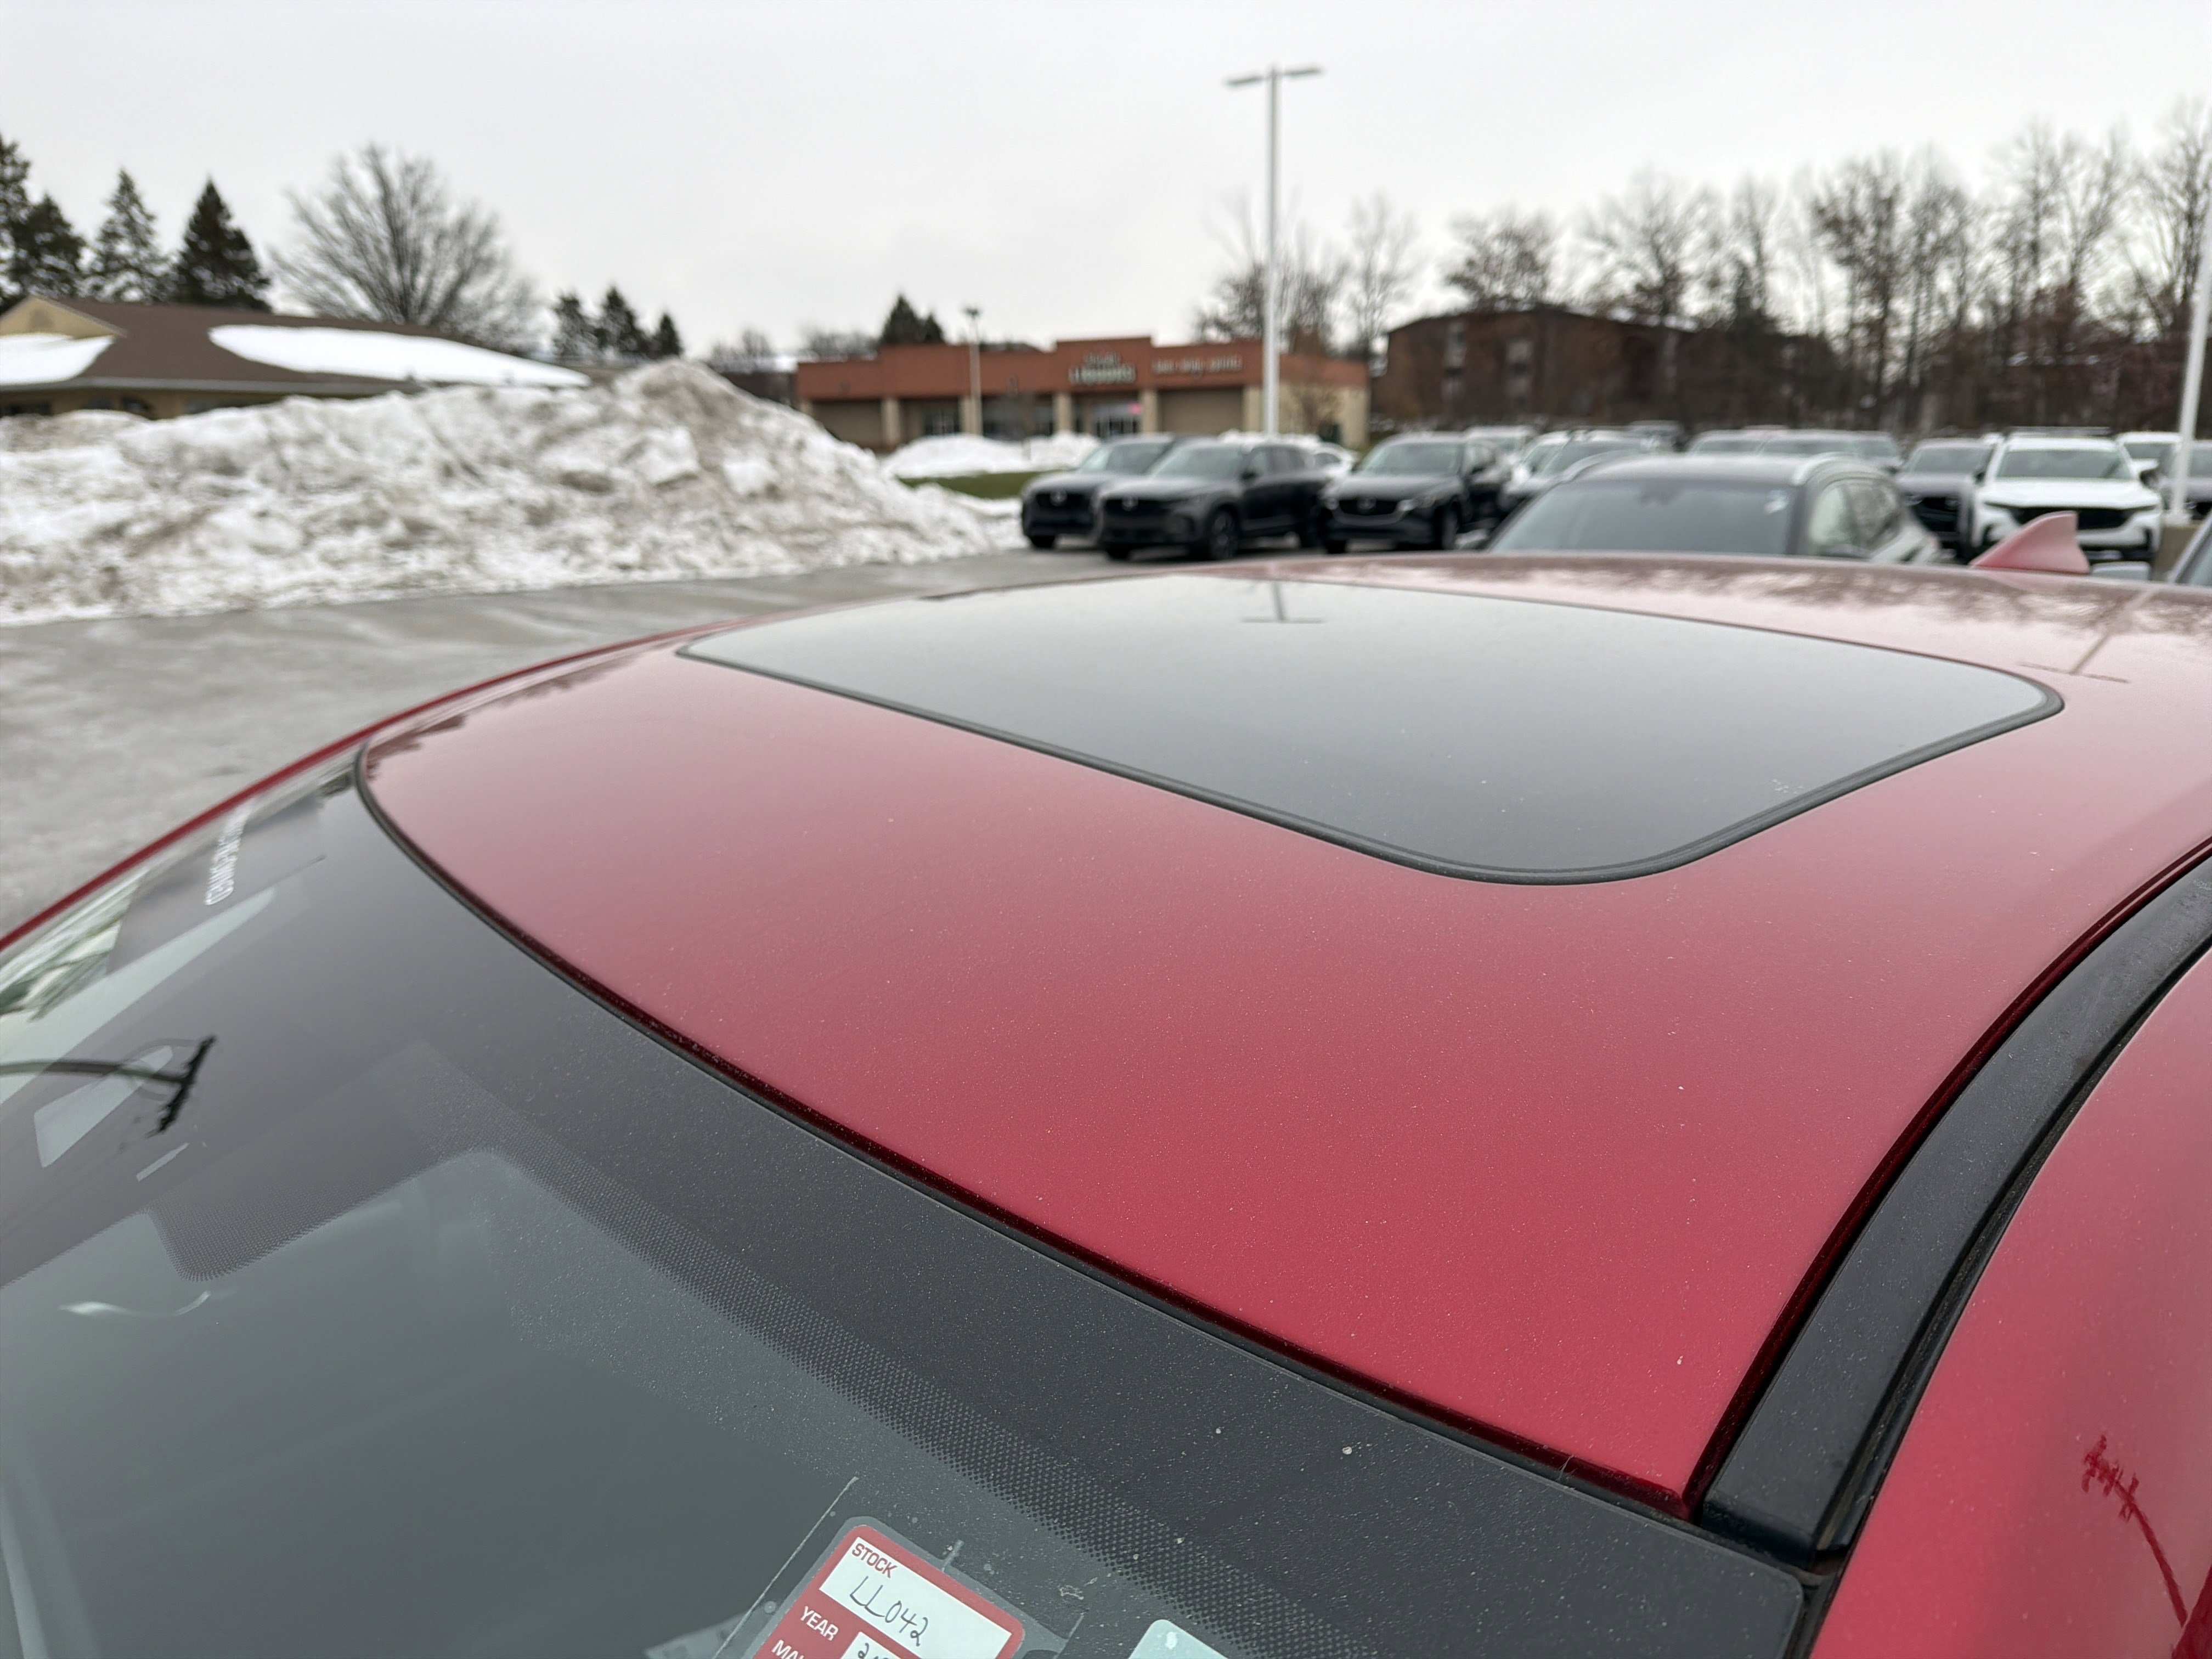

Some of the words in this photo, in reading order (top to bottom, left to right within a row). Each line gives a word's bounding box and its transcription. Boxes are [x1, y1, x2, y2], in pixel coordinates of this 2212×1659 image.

[851, 1543, 898, 1578] STOCK
[799, 1605, 839, 1641] YEAR
[849, 1576, 928, 1647] LL042
